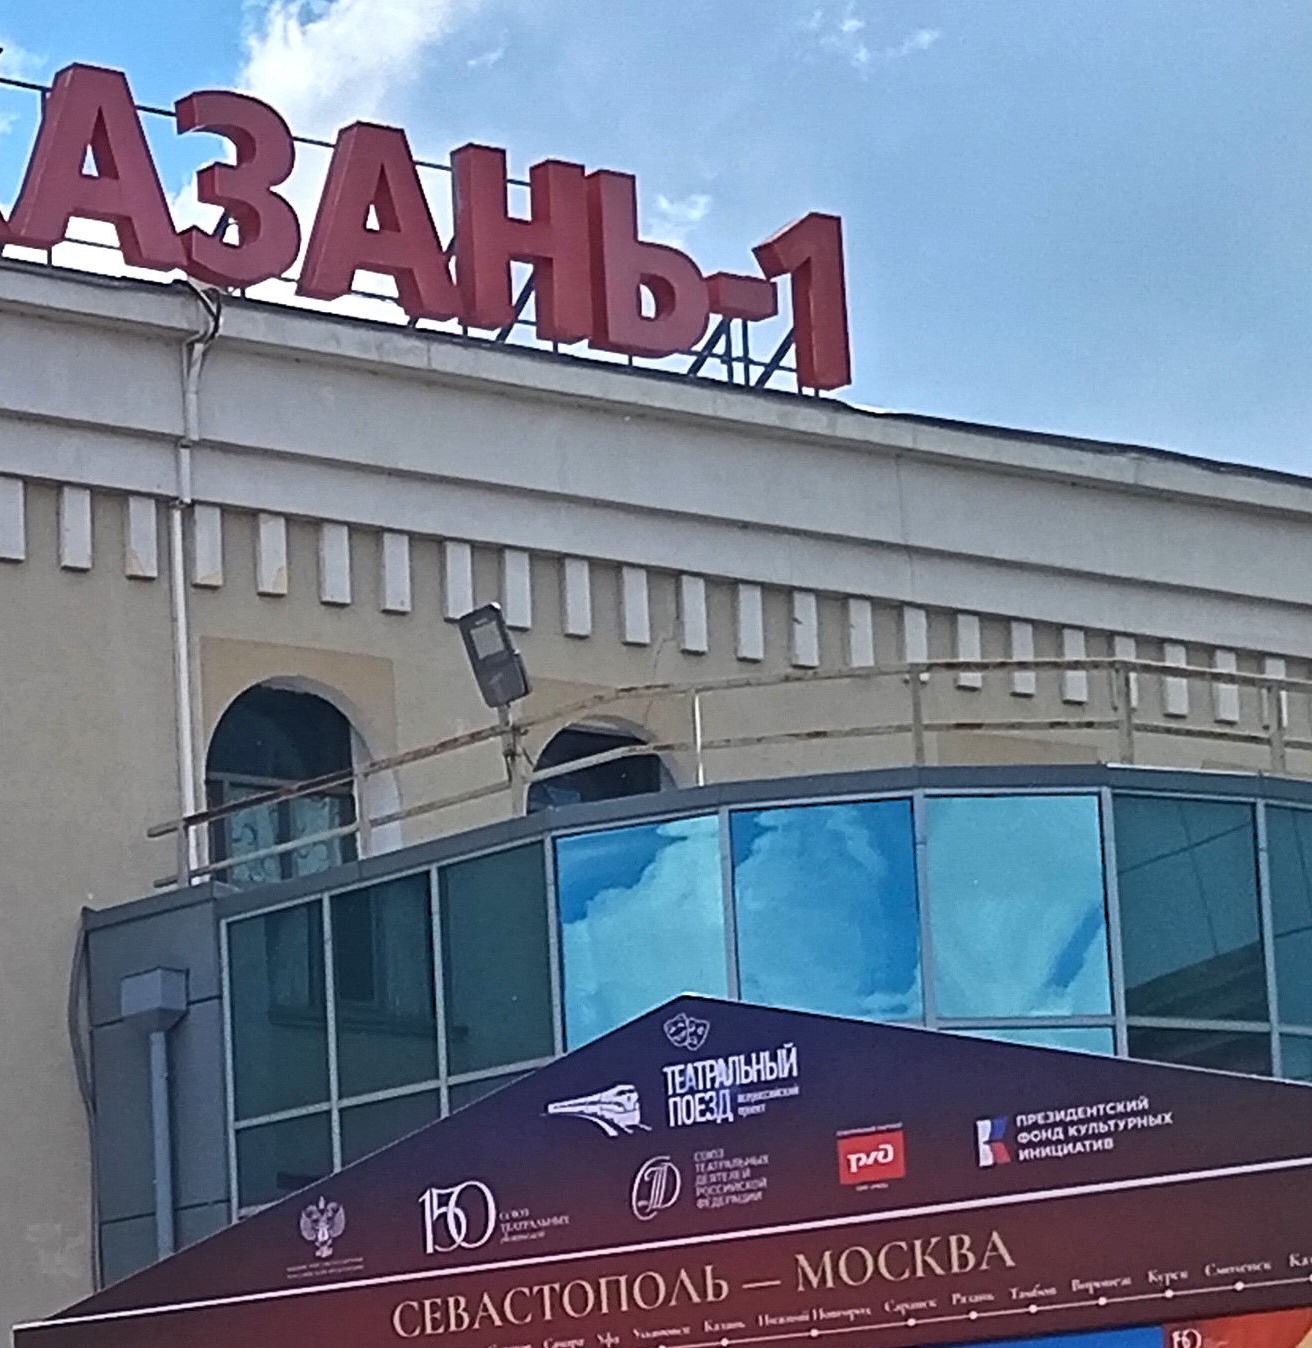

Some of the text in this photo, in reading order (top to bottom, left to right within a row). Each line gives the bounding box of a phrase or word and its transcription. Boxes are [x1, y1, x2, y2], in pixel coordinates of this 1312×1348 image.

[663, 1042, 799, 1095] ТЕАТРАЛЬНЫЙ
[668, 1089, 734, 1127] ПОЕЗД
[1016, 1096, 1149, 1127] ПРЕЗИДЕНТСКИЙ
[1017, 1112, 1173, 1144] ФОНД КУЛЬТУРНЫХ
[1018, 1137, 1115, 1161] ИНИЦИАТИВ
[418, 1180, 497, 1254] 150
[392, 1264, 729, 1338] СЕВАСТОПОЛЬ
[796, 1230, 1017, 1292] МОСКВА
